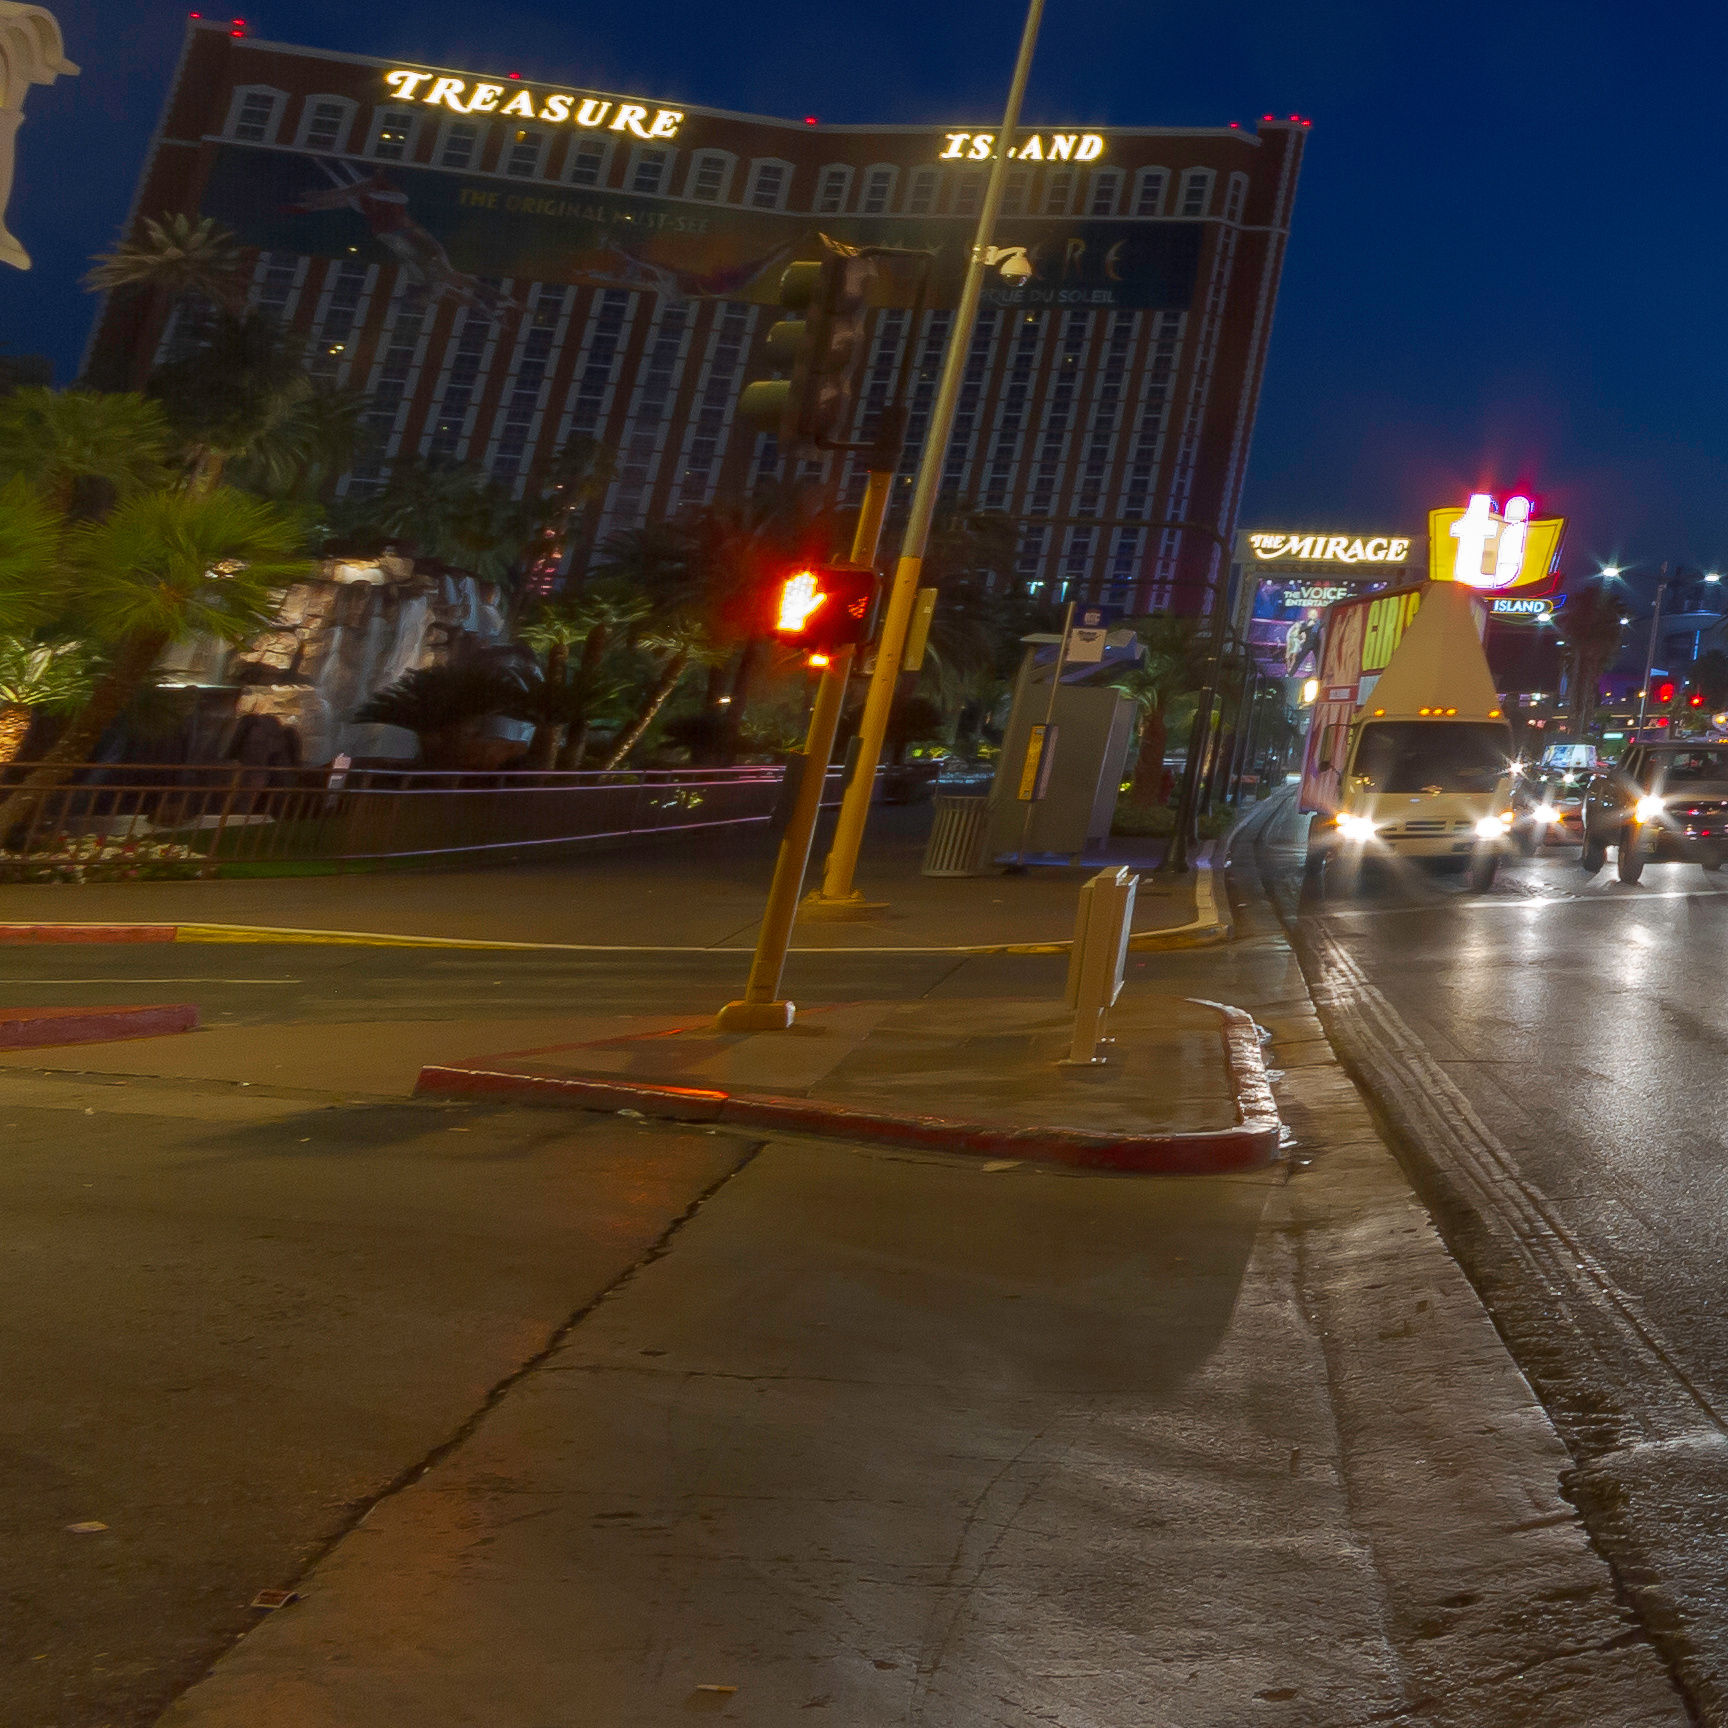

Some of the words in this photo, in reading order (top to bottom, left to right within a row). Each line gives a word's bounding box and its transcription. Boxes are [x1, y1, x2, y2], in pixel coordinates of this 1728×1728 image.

[384, 70, 686, 140] TREASURE
[1058, 290, 1116, 304] SOLEIL
[1250, 533, 1286, 550] THE
[1256, 534, 1411, 563] MIRAGE
[1301, 585, 1349, 601] VOICE
[1493, 599, 1545, 613] ISLAND
